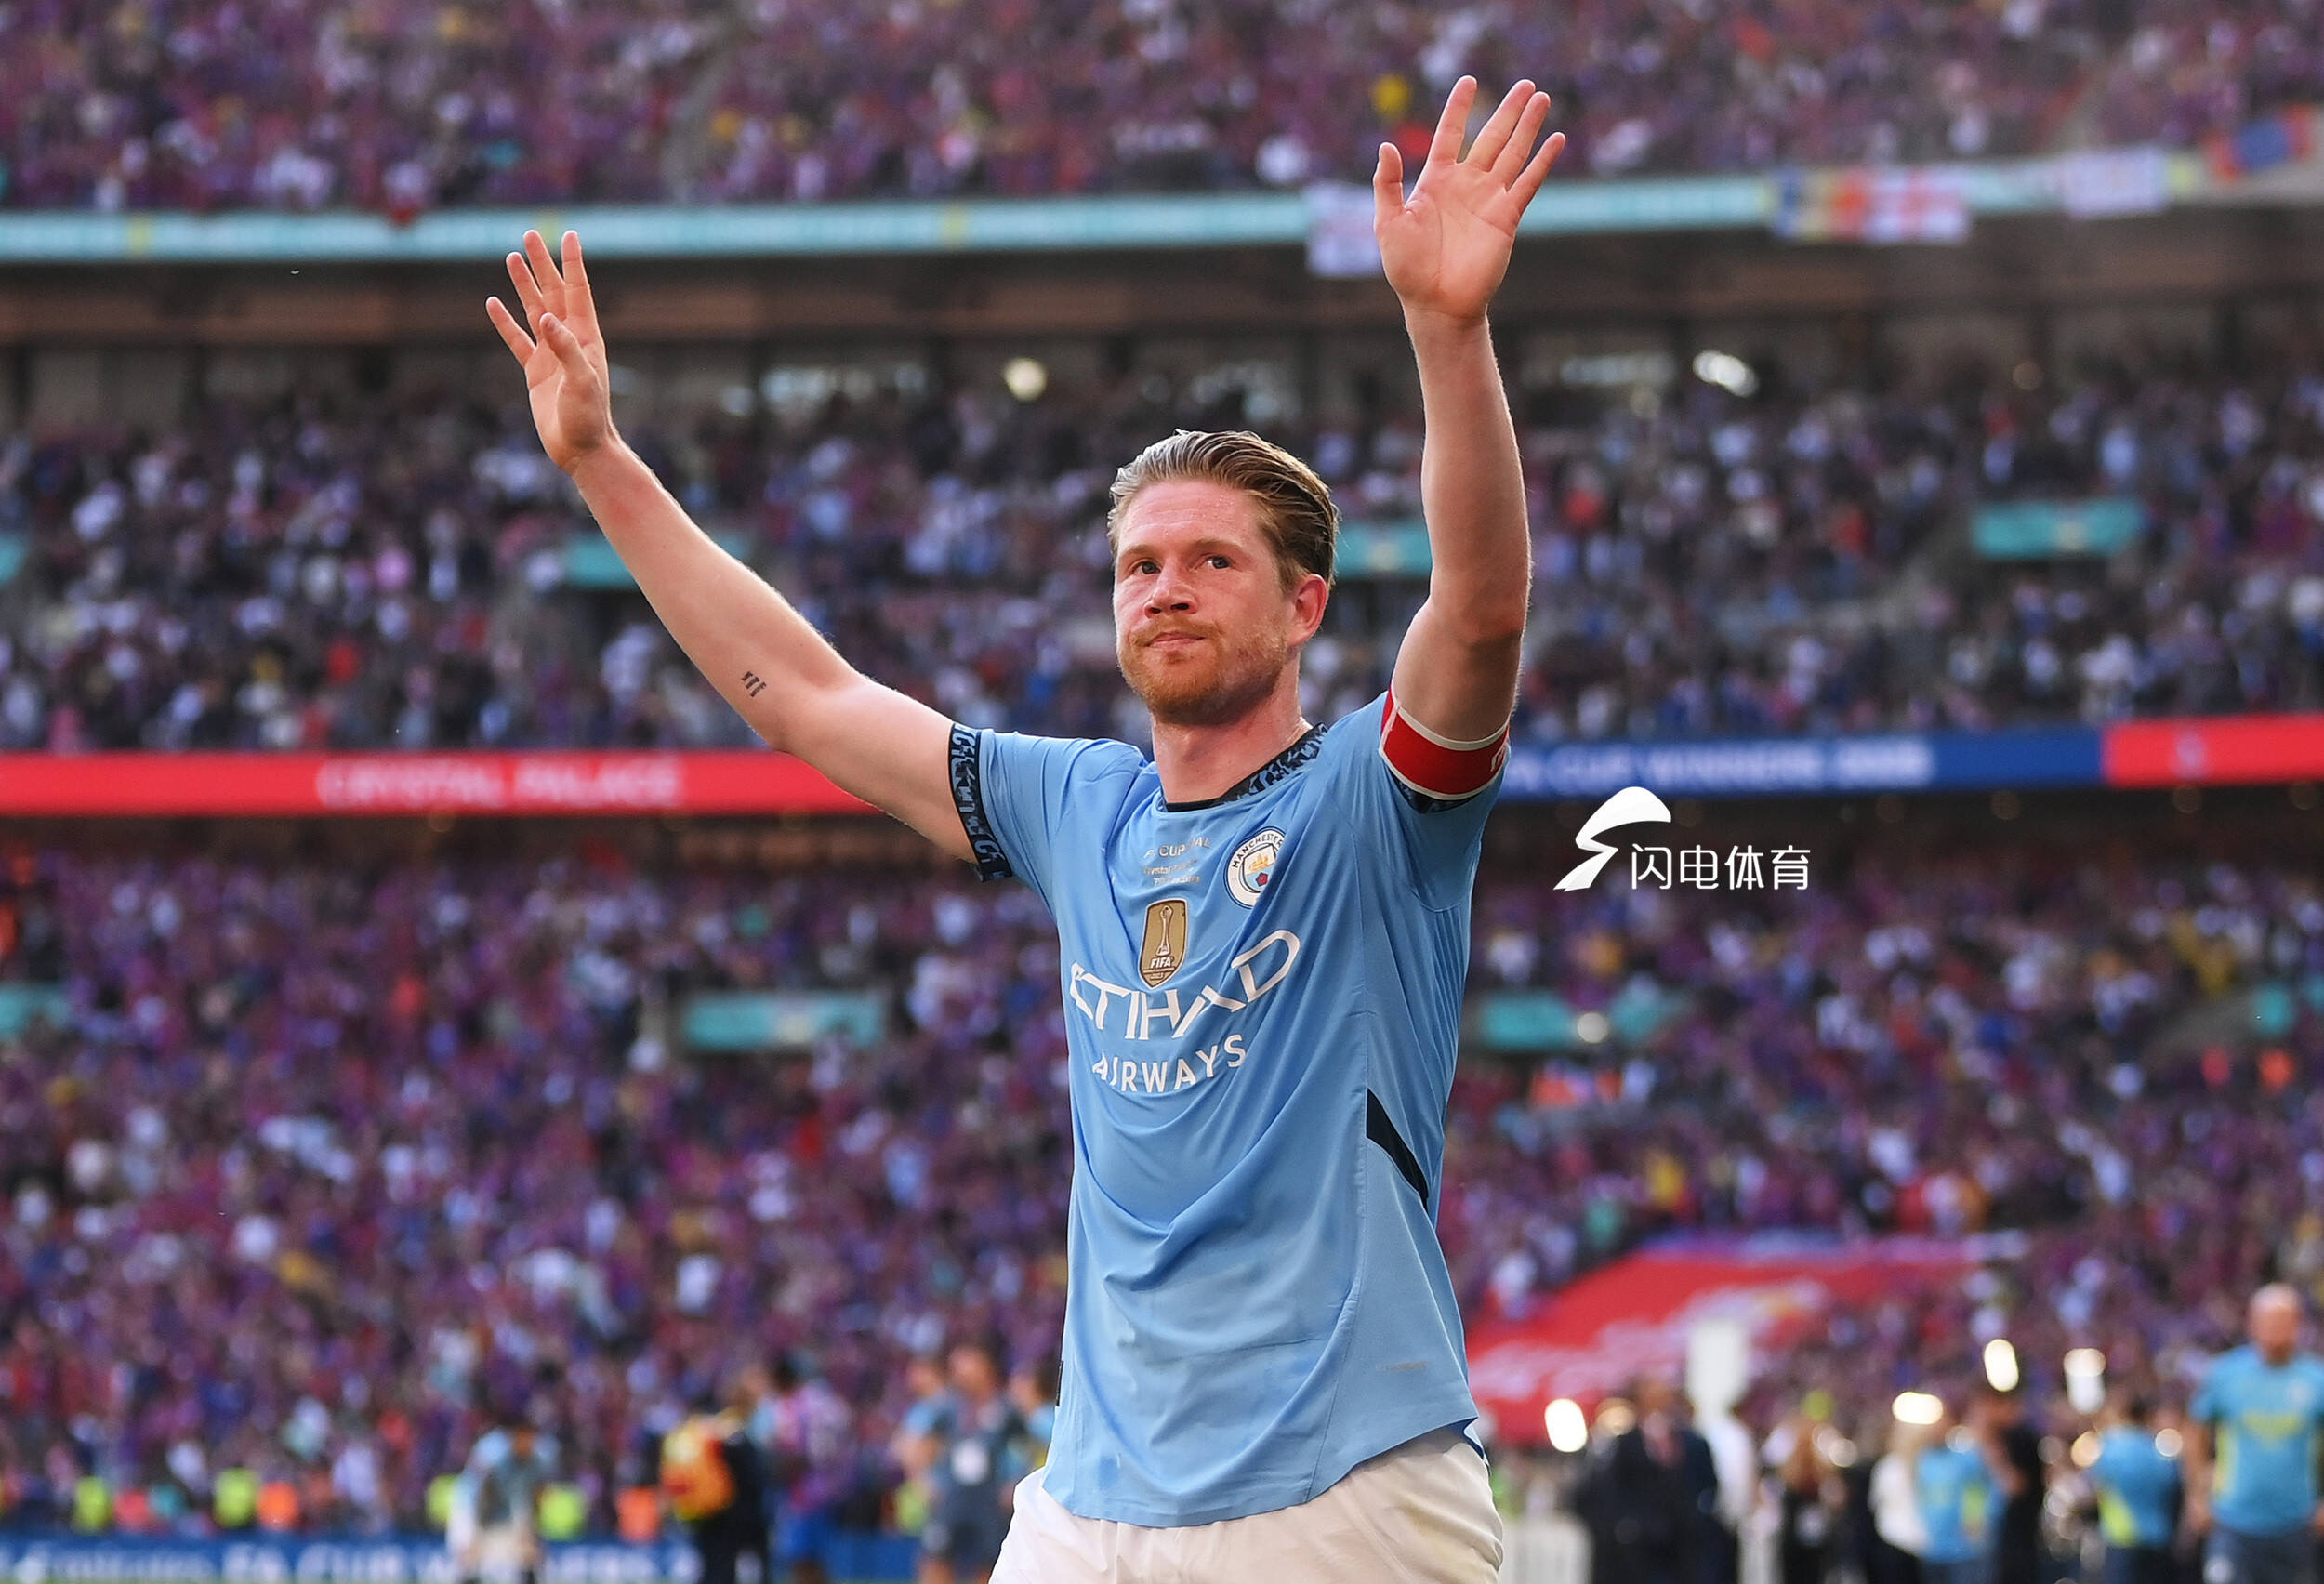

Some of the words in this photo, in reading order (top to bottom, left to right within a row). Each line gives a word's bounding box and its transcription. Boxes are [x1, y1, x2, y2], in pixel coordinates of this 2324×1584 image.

[317, 758, 505, 808] CRYSTAL
[514, 757, 681, 808] PALACE
[1159, 845, 1185, 856] CUP
[1232, 833, 1284, 869] MANCHESTER
[1150, 957, 1173, 969] FIFA
[1092, 1034, 1247, 1094] AIRWAYS
